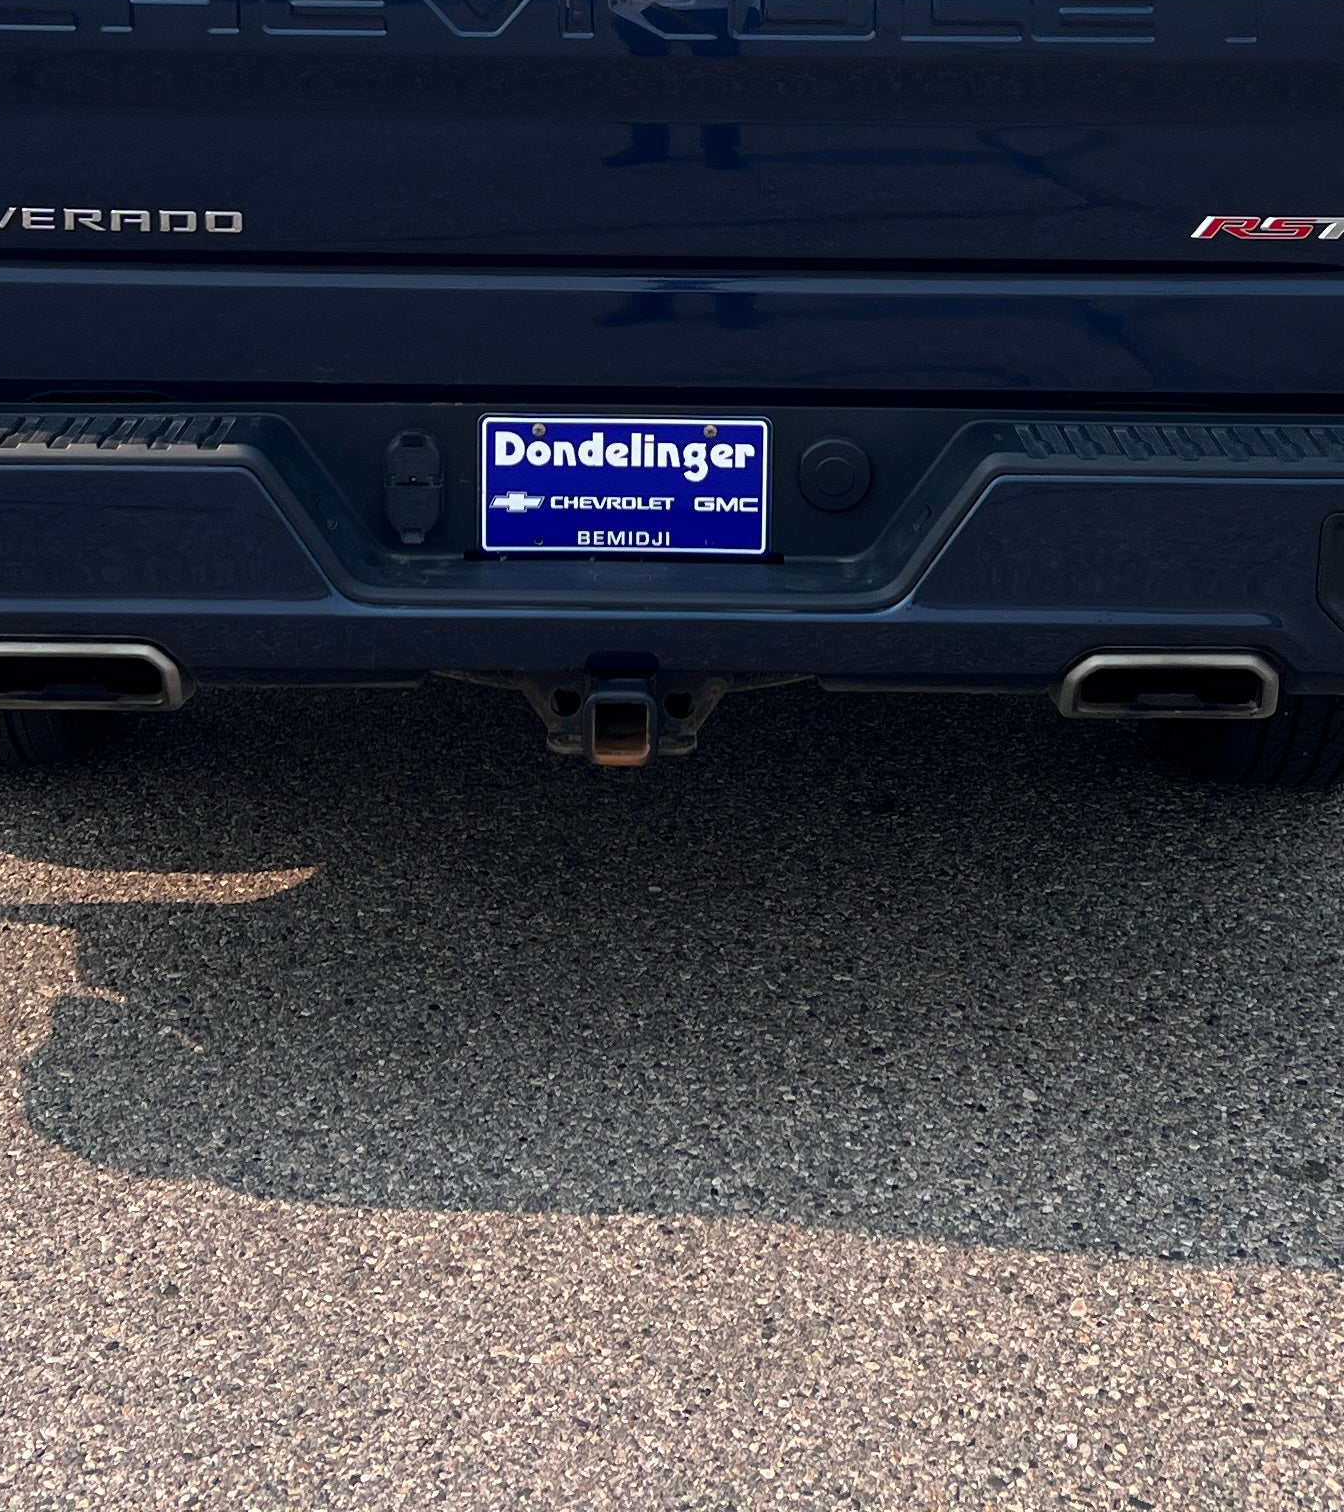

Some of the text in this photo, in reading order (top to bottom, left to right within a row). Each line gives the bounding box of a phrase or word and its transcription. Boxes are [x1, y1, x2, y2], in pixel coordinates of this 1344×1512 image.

[494, 430, 756, 482] Dondelinger
[550, 495, 759, 512] CHEVROLET GMC
[577, 530, 671, 547] BEMIDJI
